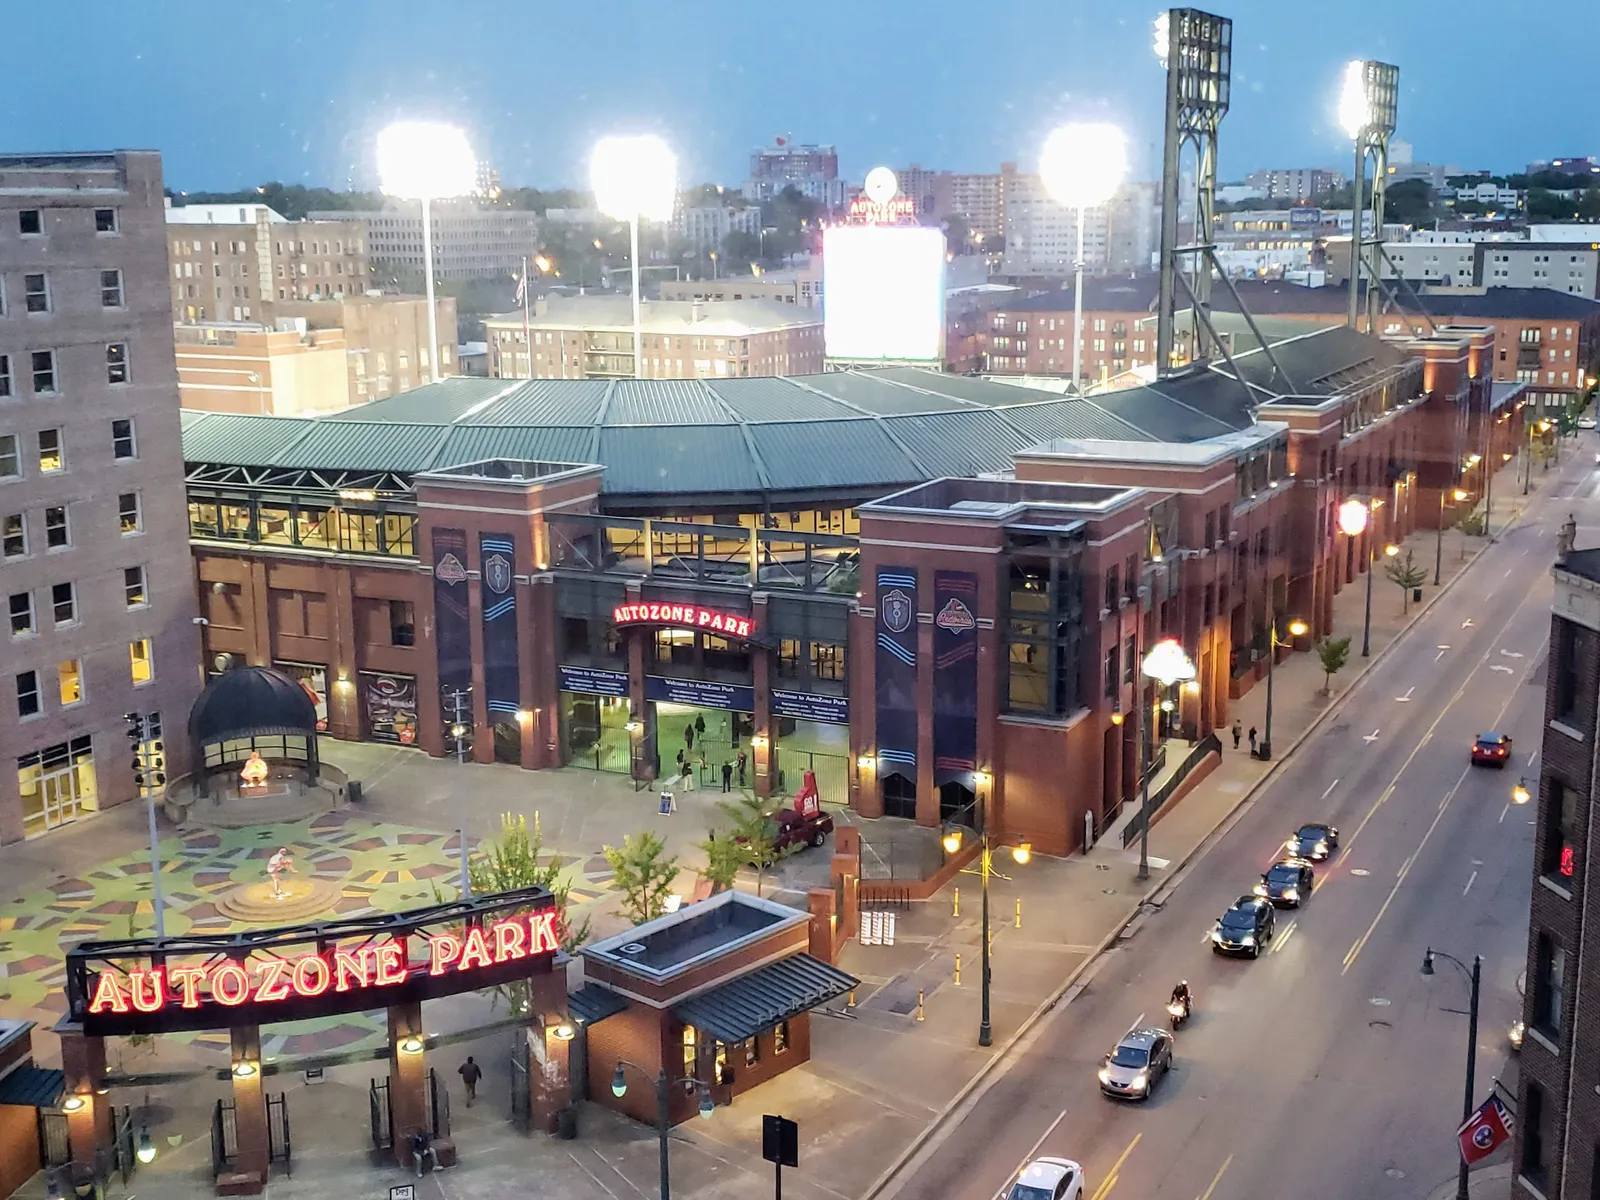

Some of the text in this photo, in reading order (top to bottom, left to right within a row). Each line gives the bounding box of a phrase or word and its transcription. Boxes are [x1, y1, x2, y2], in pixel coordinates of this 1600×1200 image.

[614, 605, 750, 637] AUTOZONE PARK
[664, 679, 688, 687] Welcome
[695, 683, 721, 691] AutoZone
[773, 691, 798, 699] Welcome
[805, 696, 832, 704] AutoZone
[88, 911, 559, 1014] AUTOZONE PARK
